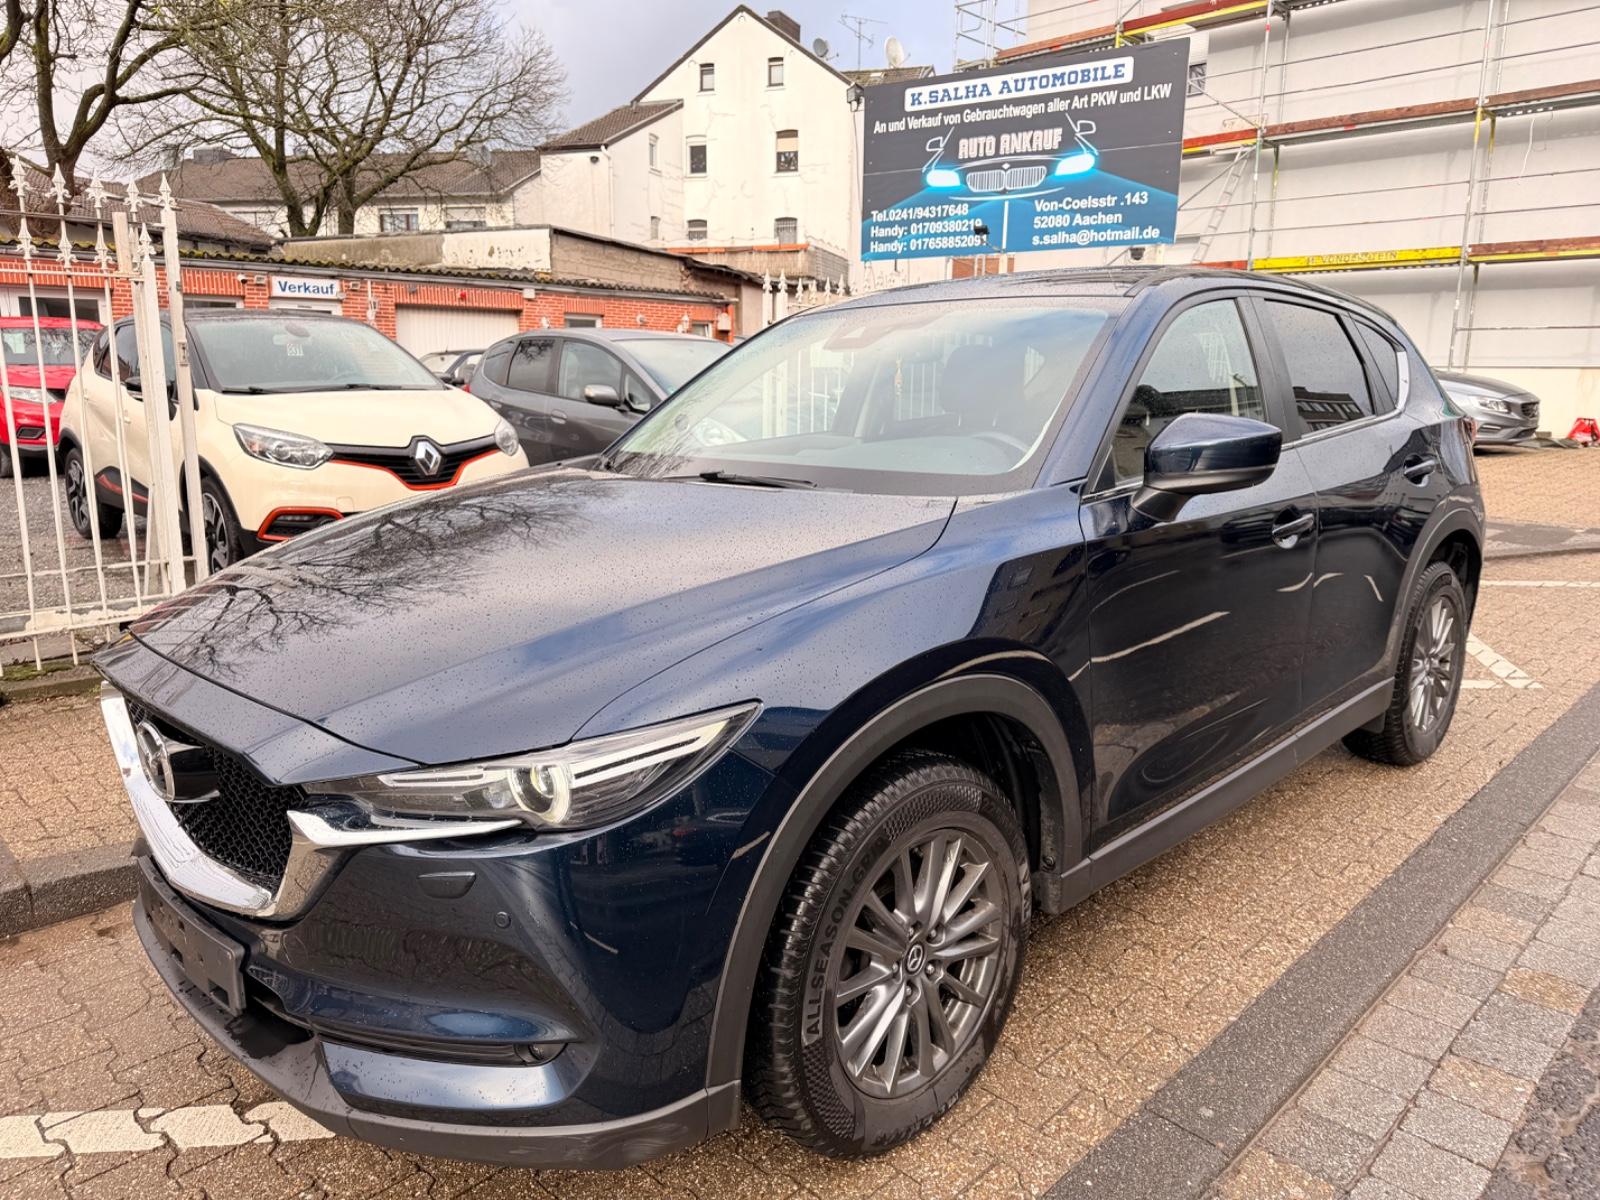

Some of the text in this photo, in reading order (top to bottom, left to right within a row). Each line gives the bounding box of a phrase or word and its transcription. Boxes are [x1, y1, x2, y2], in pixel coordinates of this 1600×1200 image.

[910, 63, 1126, 106] K.SALHA AUTOMOBILE
[873, 83, 1172, 134] An und Verkauf von Gebrauchtwagen aller Art PKW und LKW
[958, 127, 1062, 159] AUTO ANKAUF
[1034, 194, 1118, 212] Von-Coelsstr
[871, 203, 969, 222] Tel.0241/94317648
[1033, 212, 1122, 229] 52080 Aachen
[870, 225, 908, 239] Handy:
[1032, 226, 1160, 245] s.salha@hotmail.de
[870, 239, 907, 254] Handy:
[278, 281, 334, 294] Verkauf
